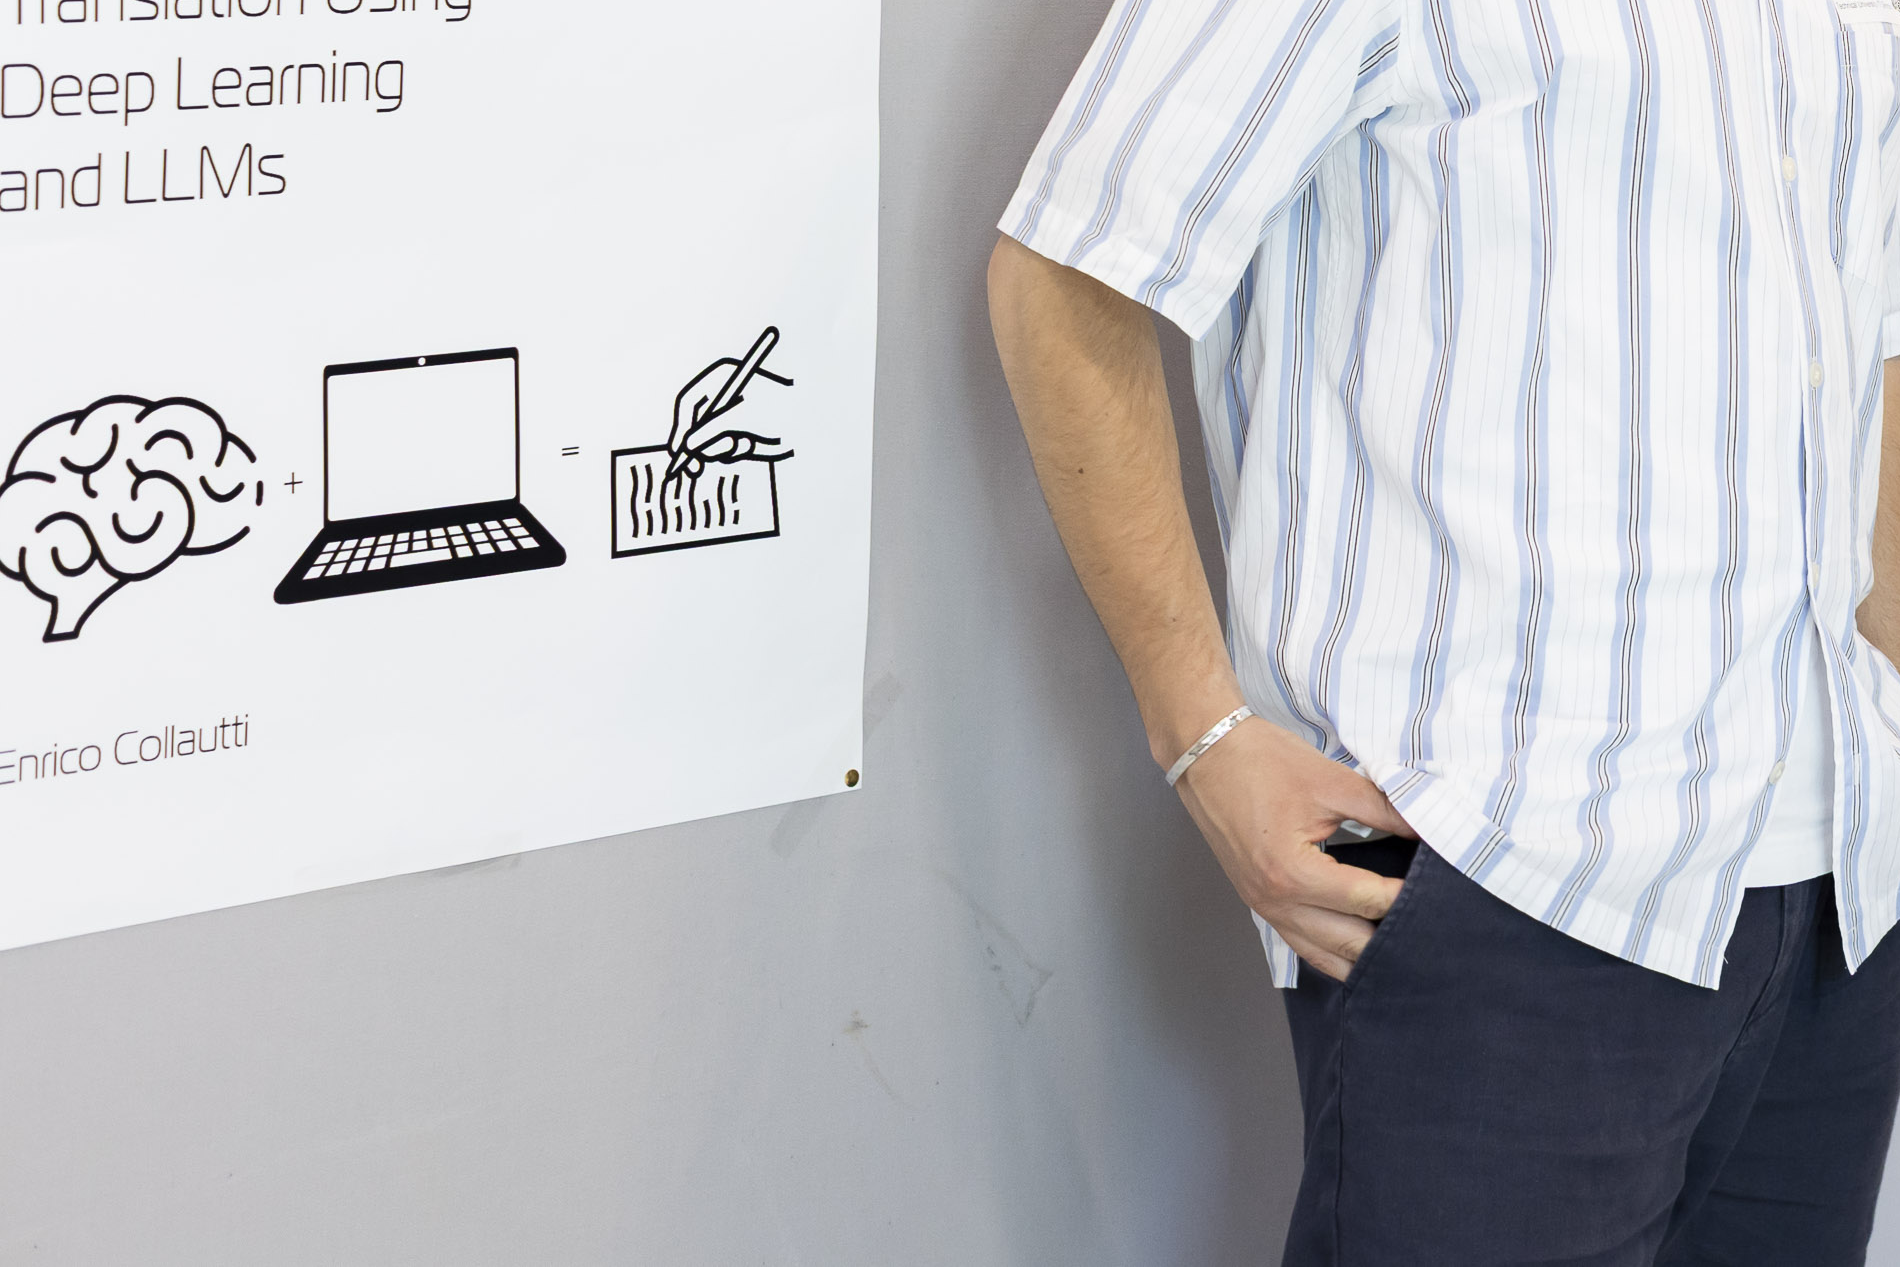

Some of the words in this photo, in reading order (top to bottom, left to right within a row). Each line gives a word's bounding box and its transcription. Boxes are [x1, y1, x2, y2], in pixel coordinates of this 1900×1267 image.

[0, 61, 156, 127] Deep
[176, 50, 404, 113] Learning
[0, 152, 101, 212] and
[124, 142, 287, 206] LLMs
[0, 743, 102, 786] Enrico
[114, 714, 250, 768] Collautti
